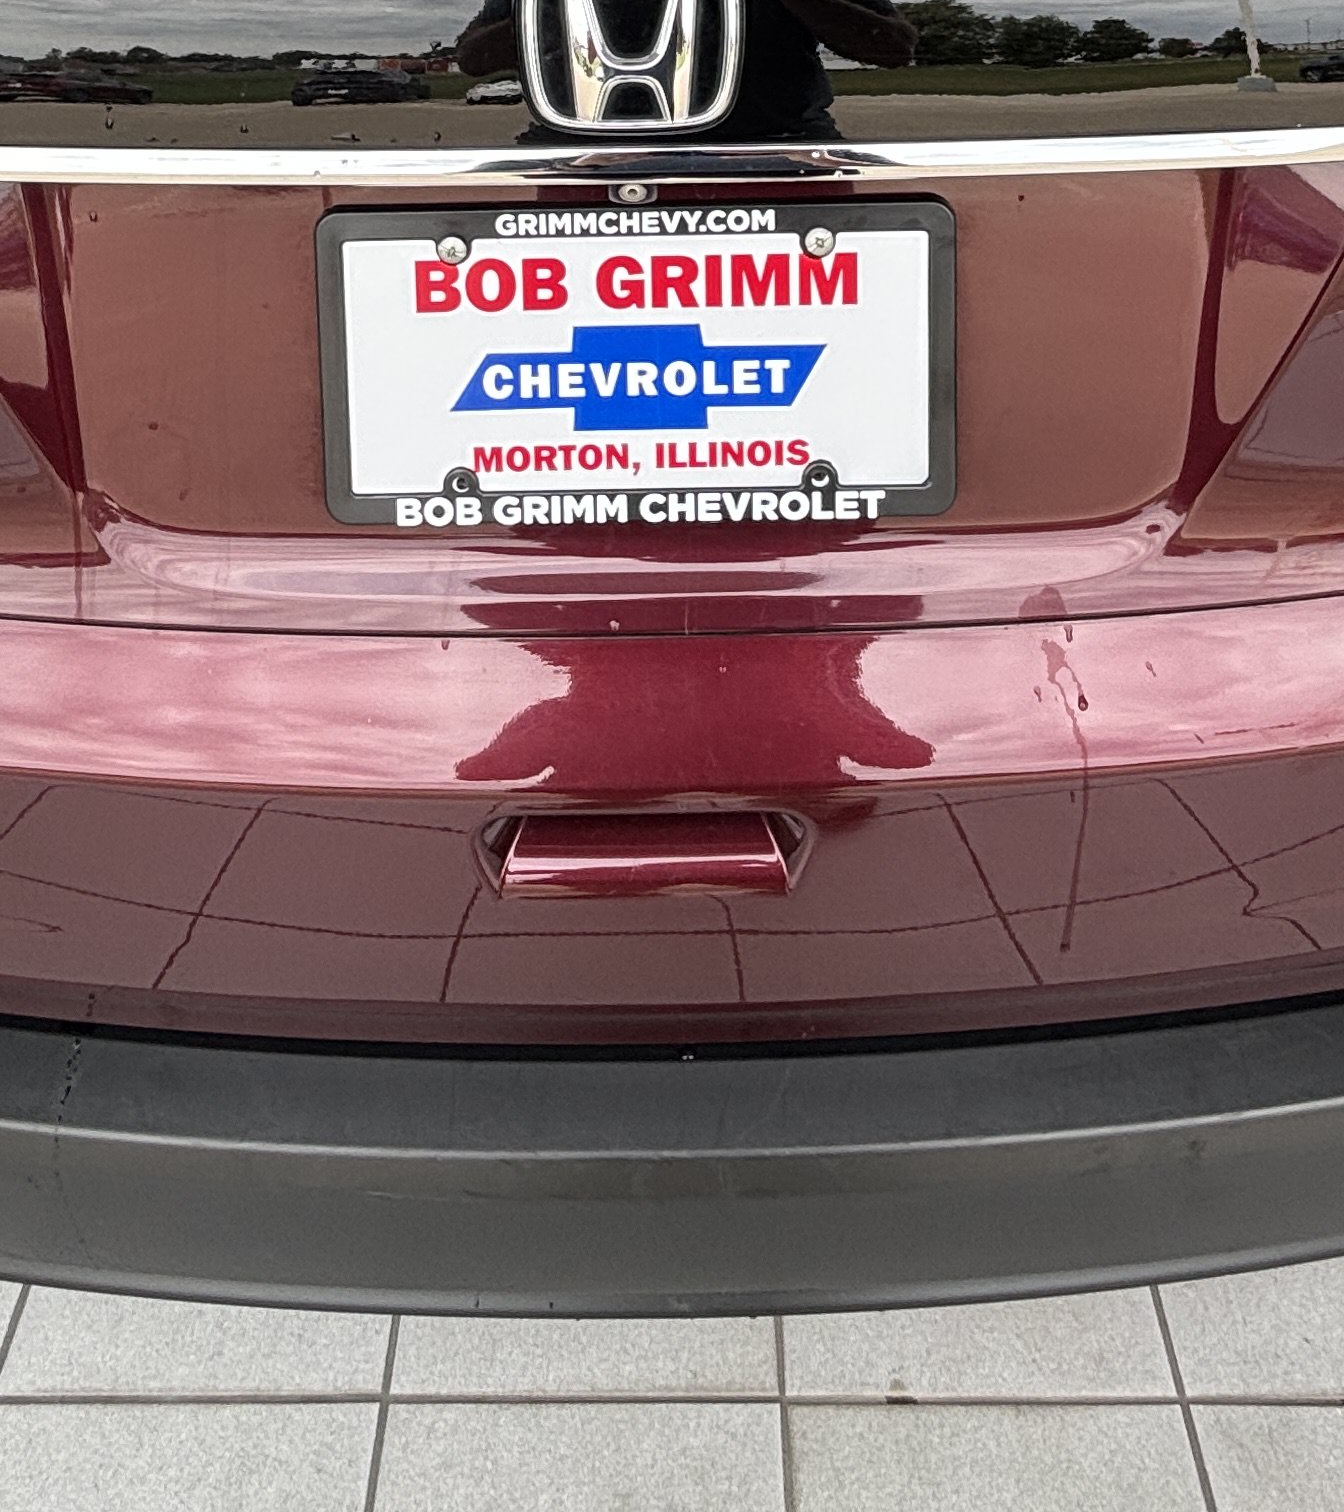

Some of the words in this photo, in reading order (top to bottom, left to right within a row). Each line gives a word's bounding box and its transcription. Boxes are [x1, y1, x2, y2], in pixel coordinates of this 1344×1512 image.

[495, 208, 777, 237] GRIMMCHEVY.COM
[414, 257, 568, 313] BOB
[596, 252, 859, 309] GRIMM
[482, 358, 792, 401] CHEVROLET
[473, 441, 642, 477] MORTON,
[655, 439, 811, 470] ILLINOIS
[396, 495, 483, 527] BOB
[492, 492, 629, 526] GRIMM
[640, 490, 885, 522] CHEVROLET
